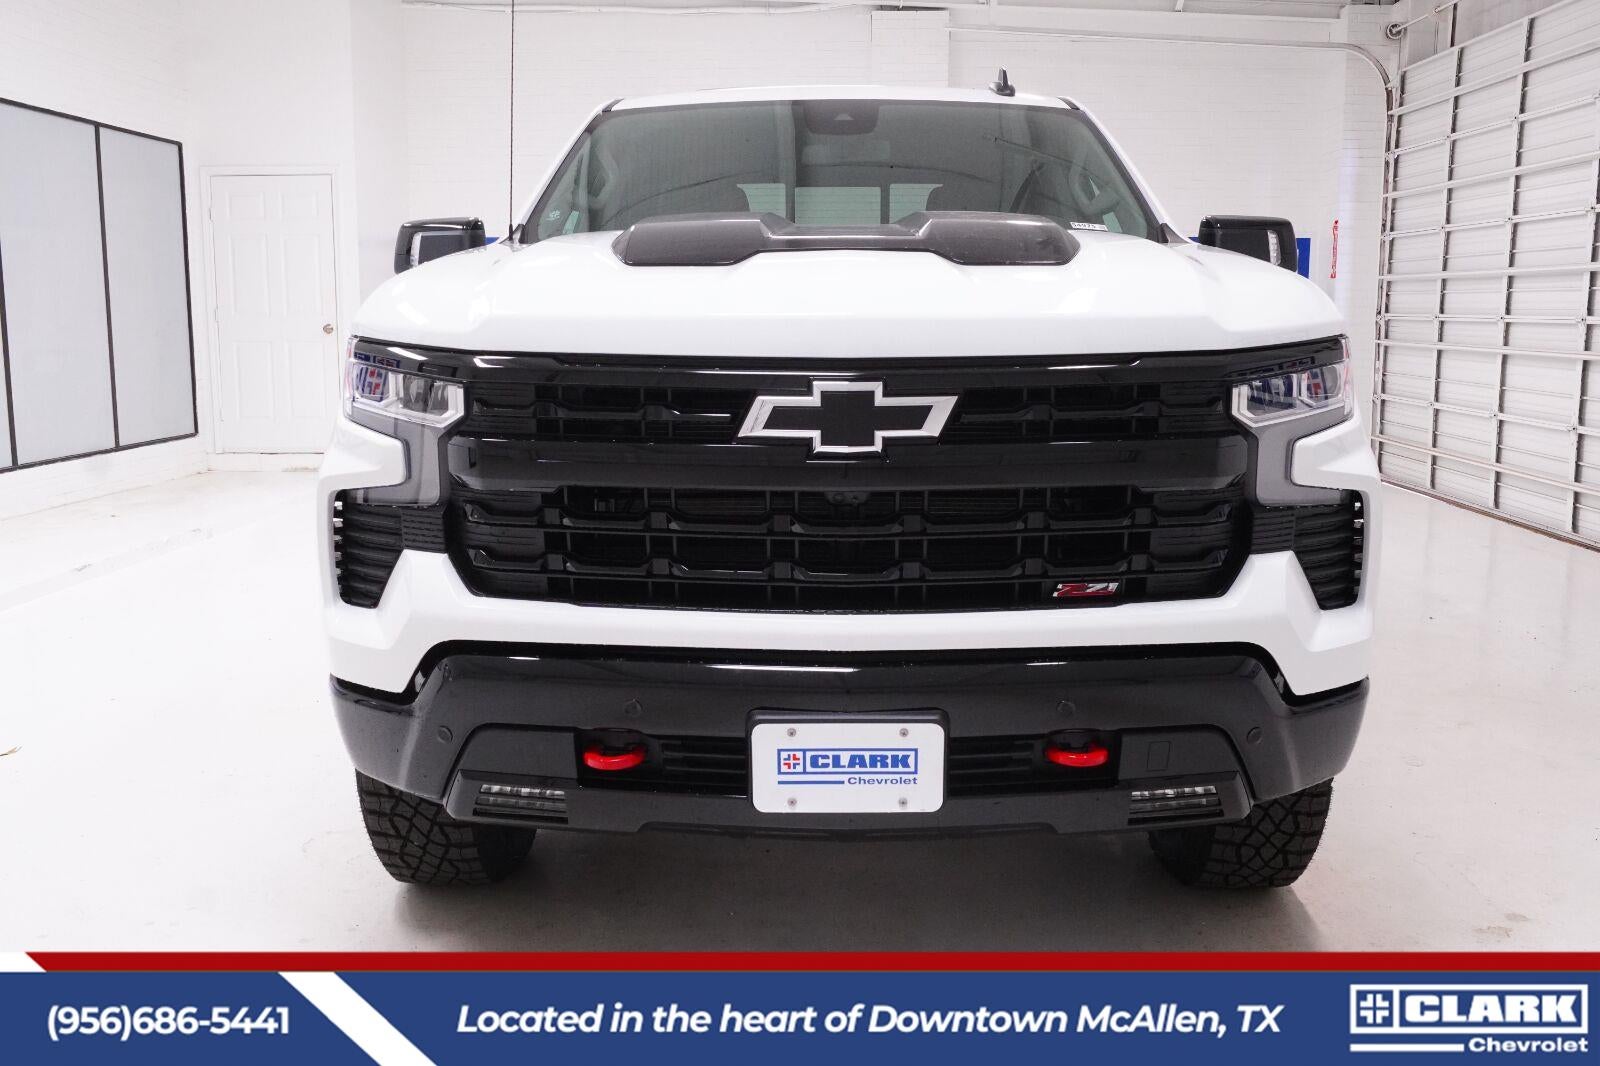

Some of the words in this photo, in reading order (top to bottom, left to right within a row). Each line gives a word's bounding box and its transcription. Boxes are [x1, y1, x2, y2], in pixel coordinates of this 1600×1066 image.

[1053, 582, 1119, 597] Z71
[809, 754, 911, 769] CLARK
[847, 776, 918, 786] Chevrolet
